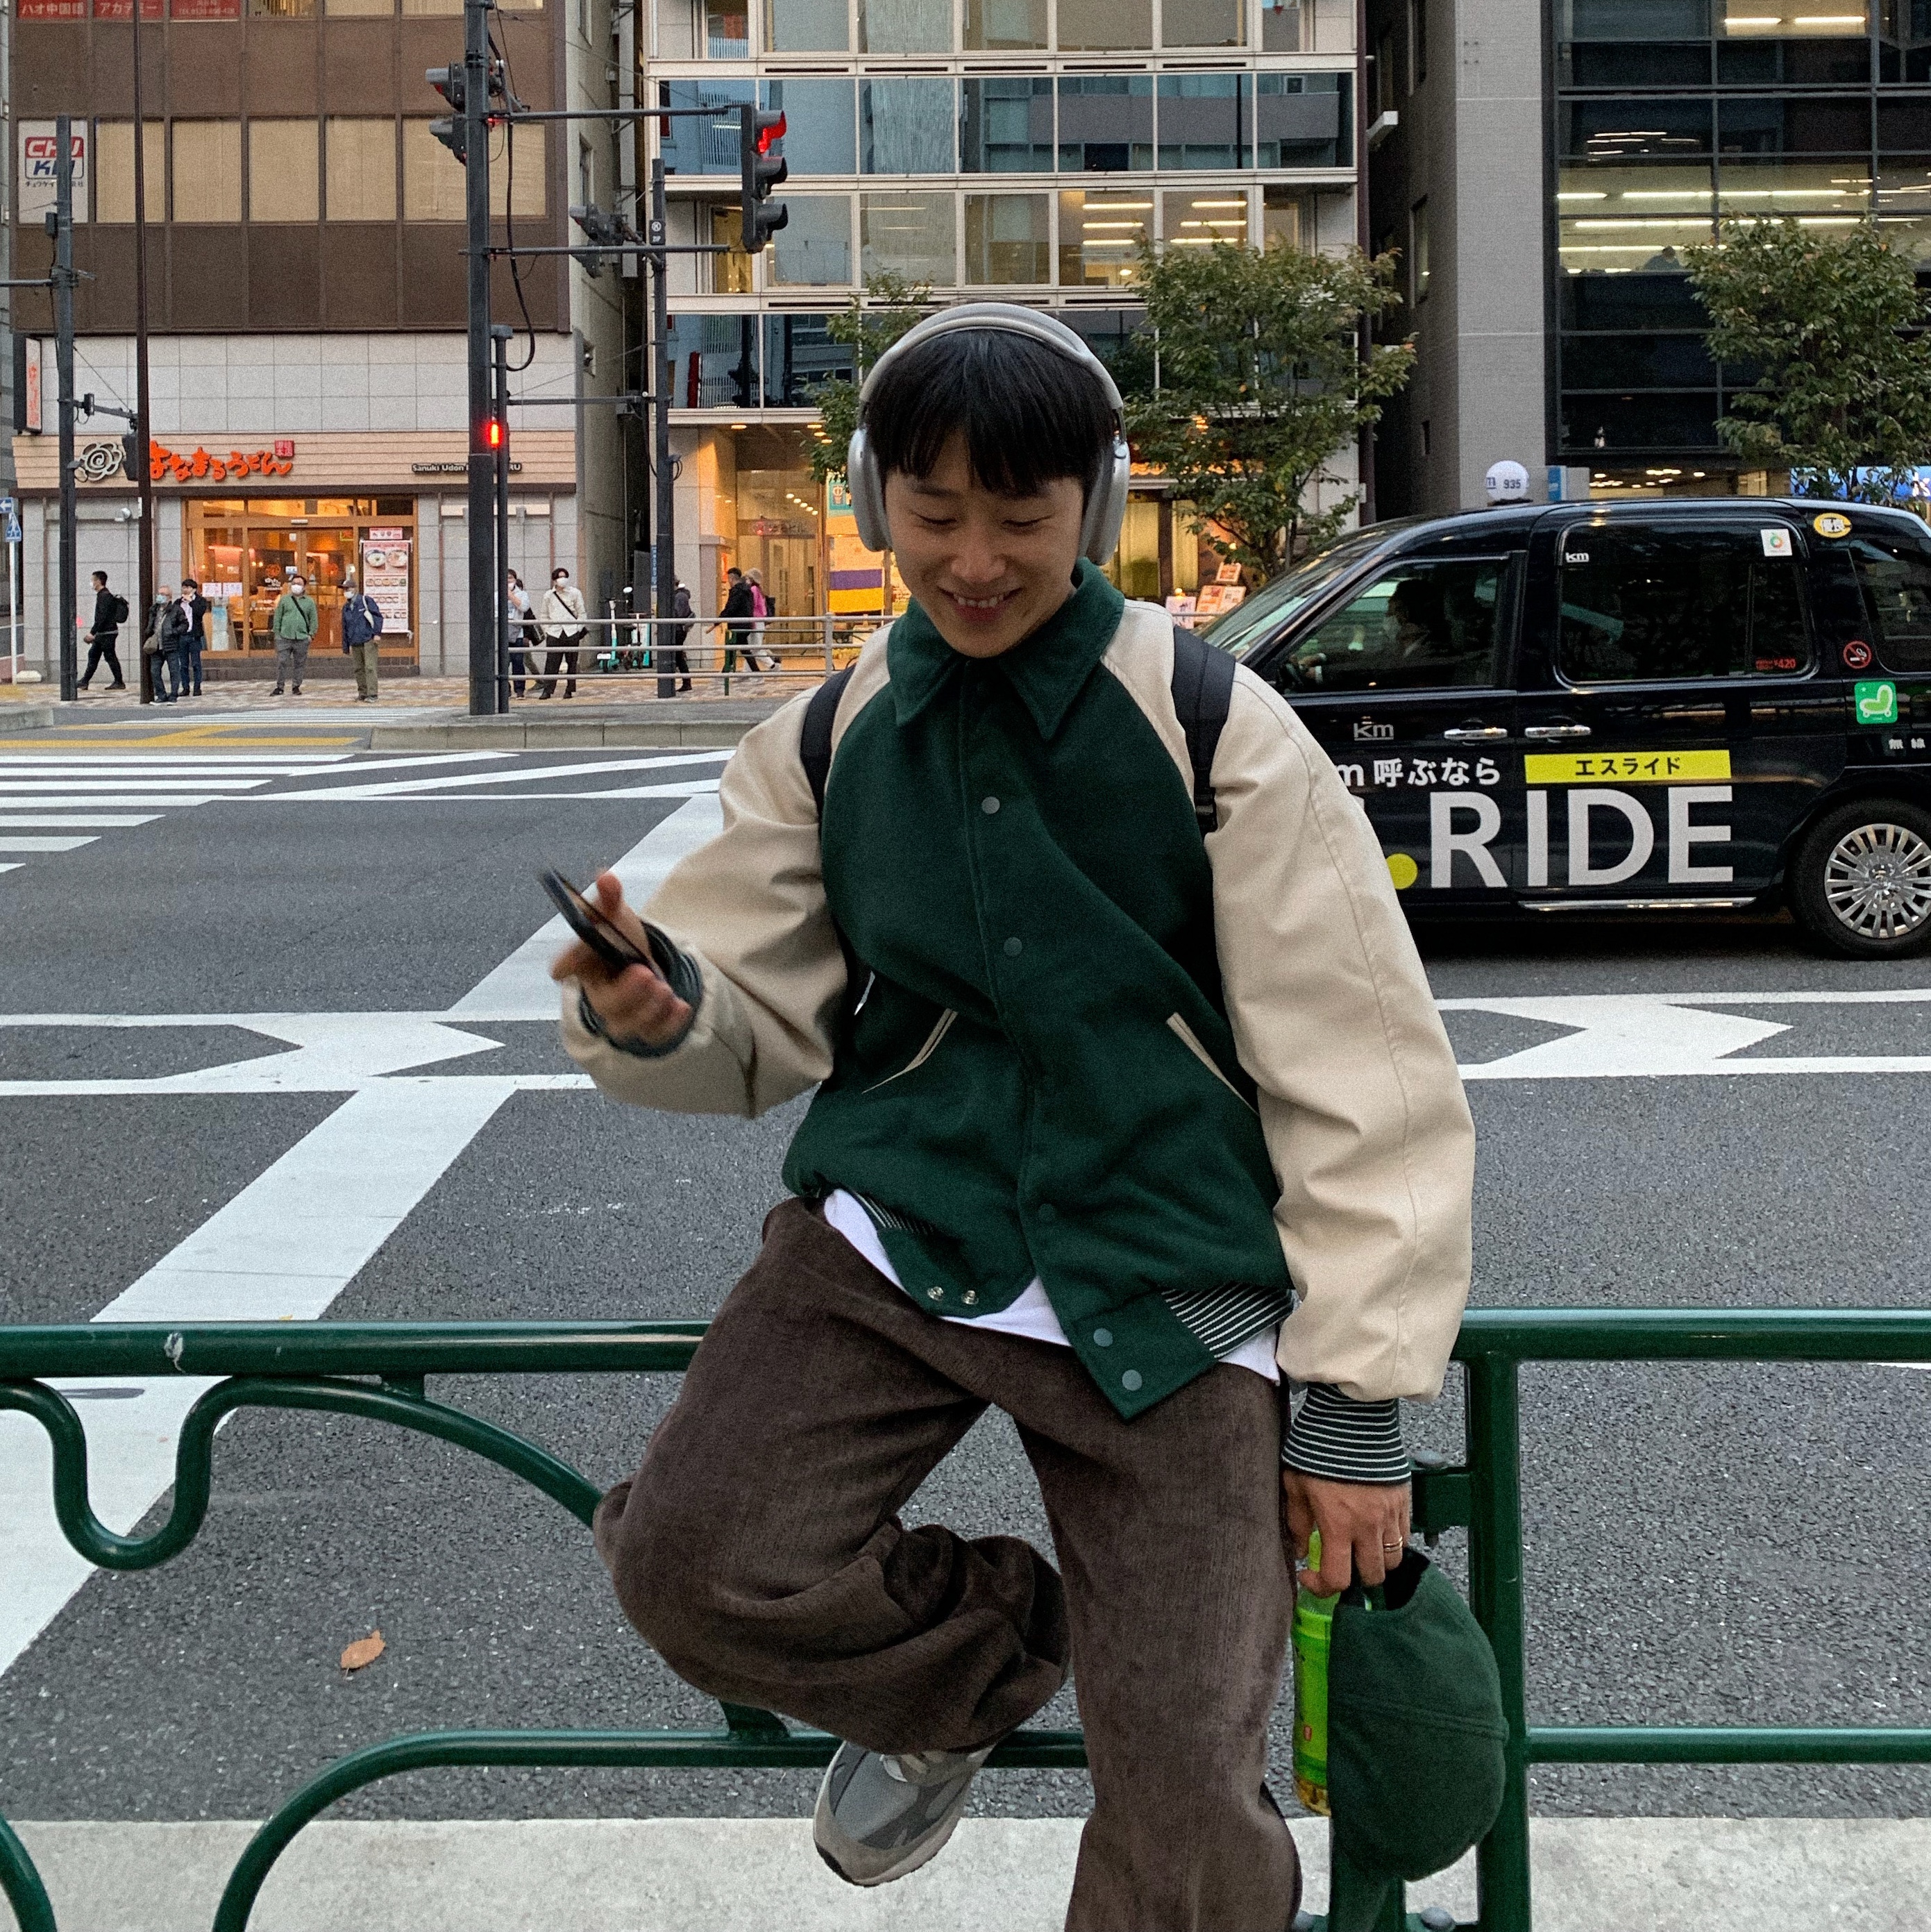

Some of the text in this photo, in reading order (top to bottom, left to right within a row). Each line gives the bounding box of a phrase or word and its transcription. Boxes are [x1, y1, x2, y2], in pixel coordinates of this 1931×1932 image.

[412, 464, 440, 472] Sanuki
[441, 464, 464, 472] Udon
[1503, 479, 1521, 489] 935
[1575, 757, 1681, 777] エスライド
